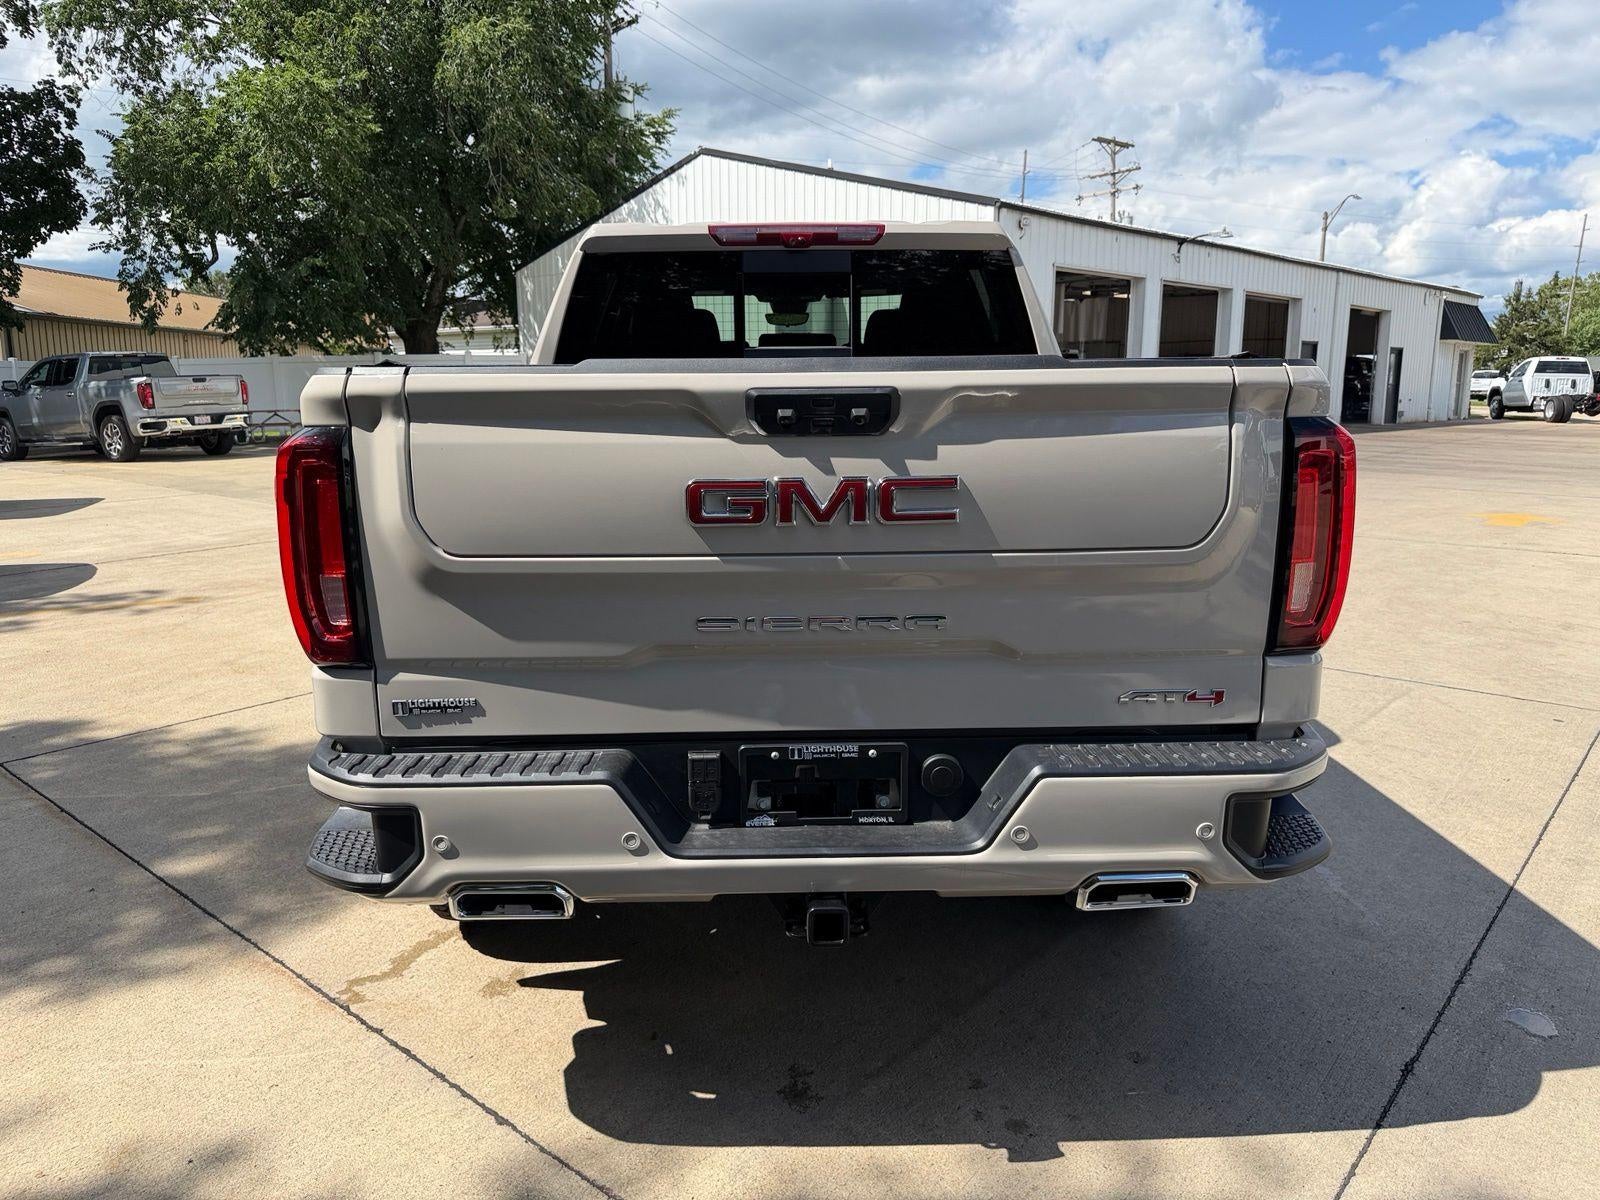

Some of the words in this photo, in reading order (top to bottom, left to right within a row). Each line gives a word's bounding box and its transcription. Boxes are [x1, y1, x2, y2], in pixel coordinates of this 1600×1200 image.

[685, 475, 960, 526] GMC
[696, 615, 948, 631] SIERRA
[408, 698, 476, 708] LIGHTHOUSE
[1118, 688, 1225, 707] AT4
[803, 745, 859, 753] LIGHTHOUSE
